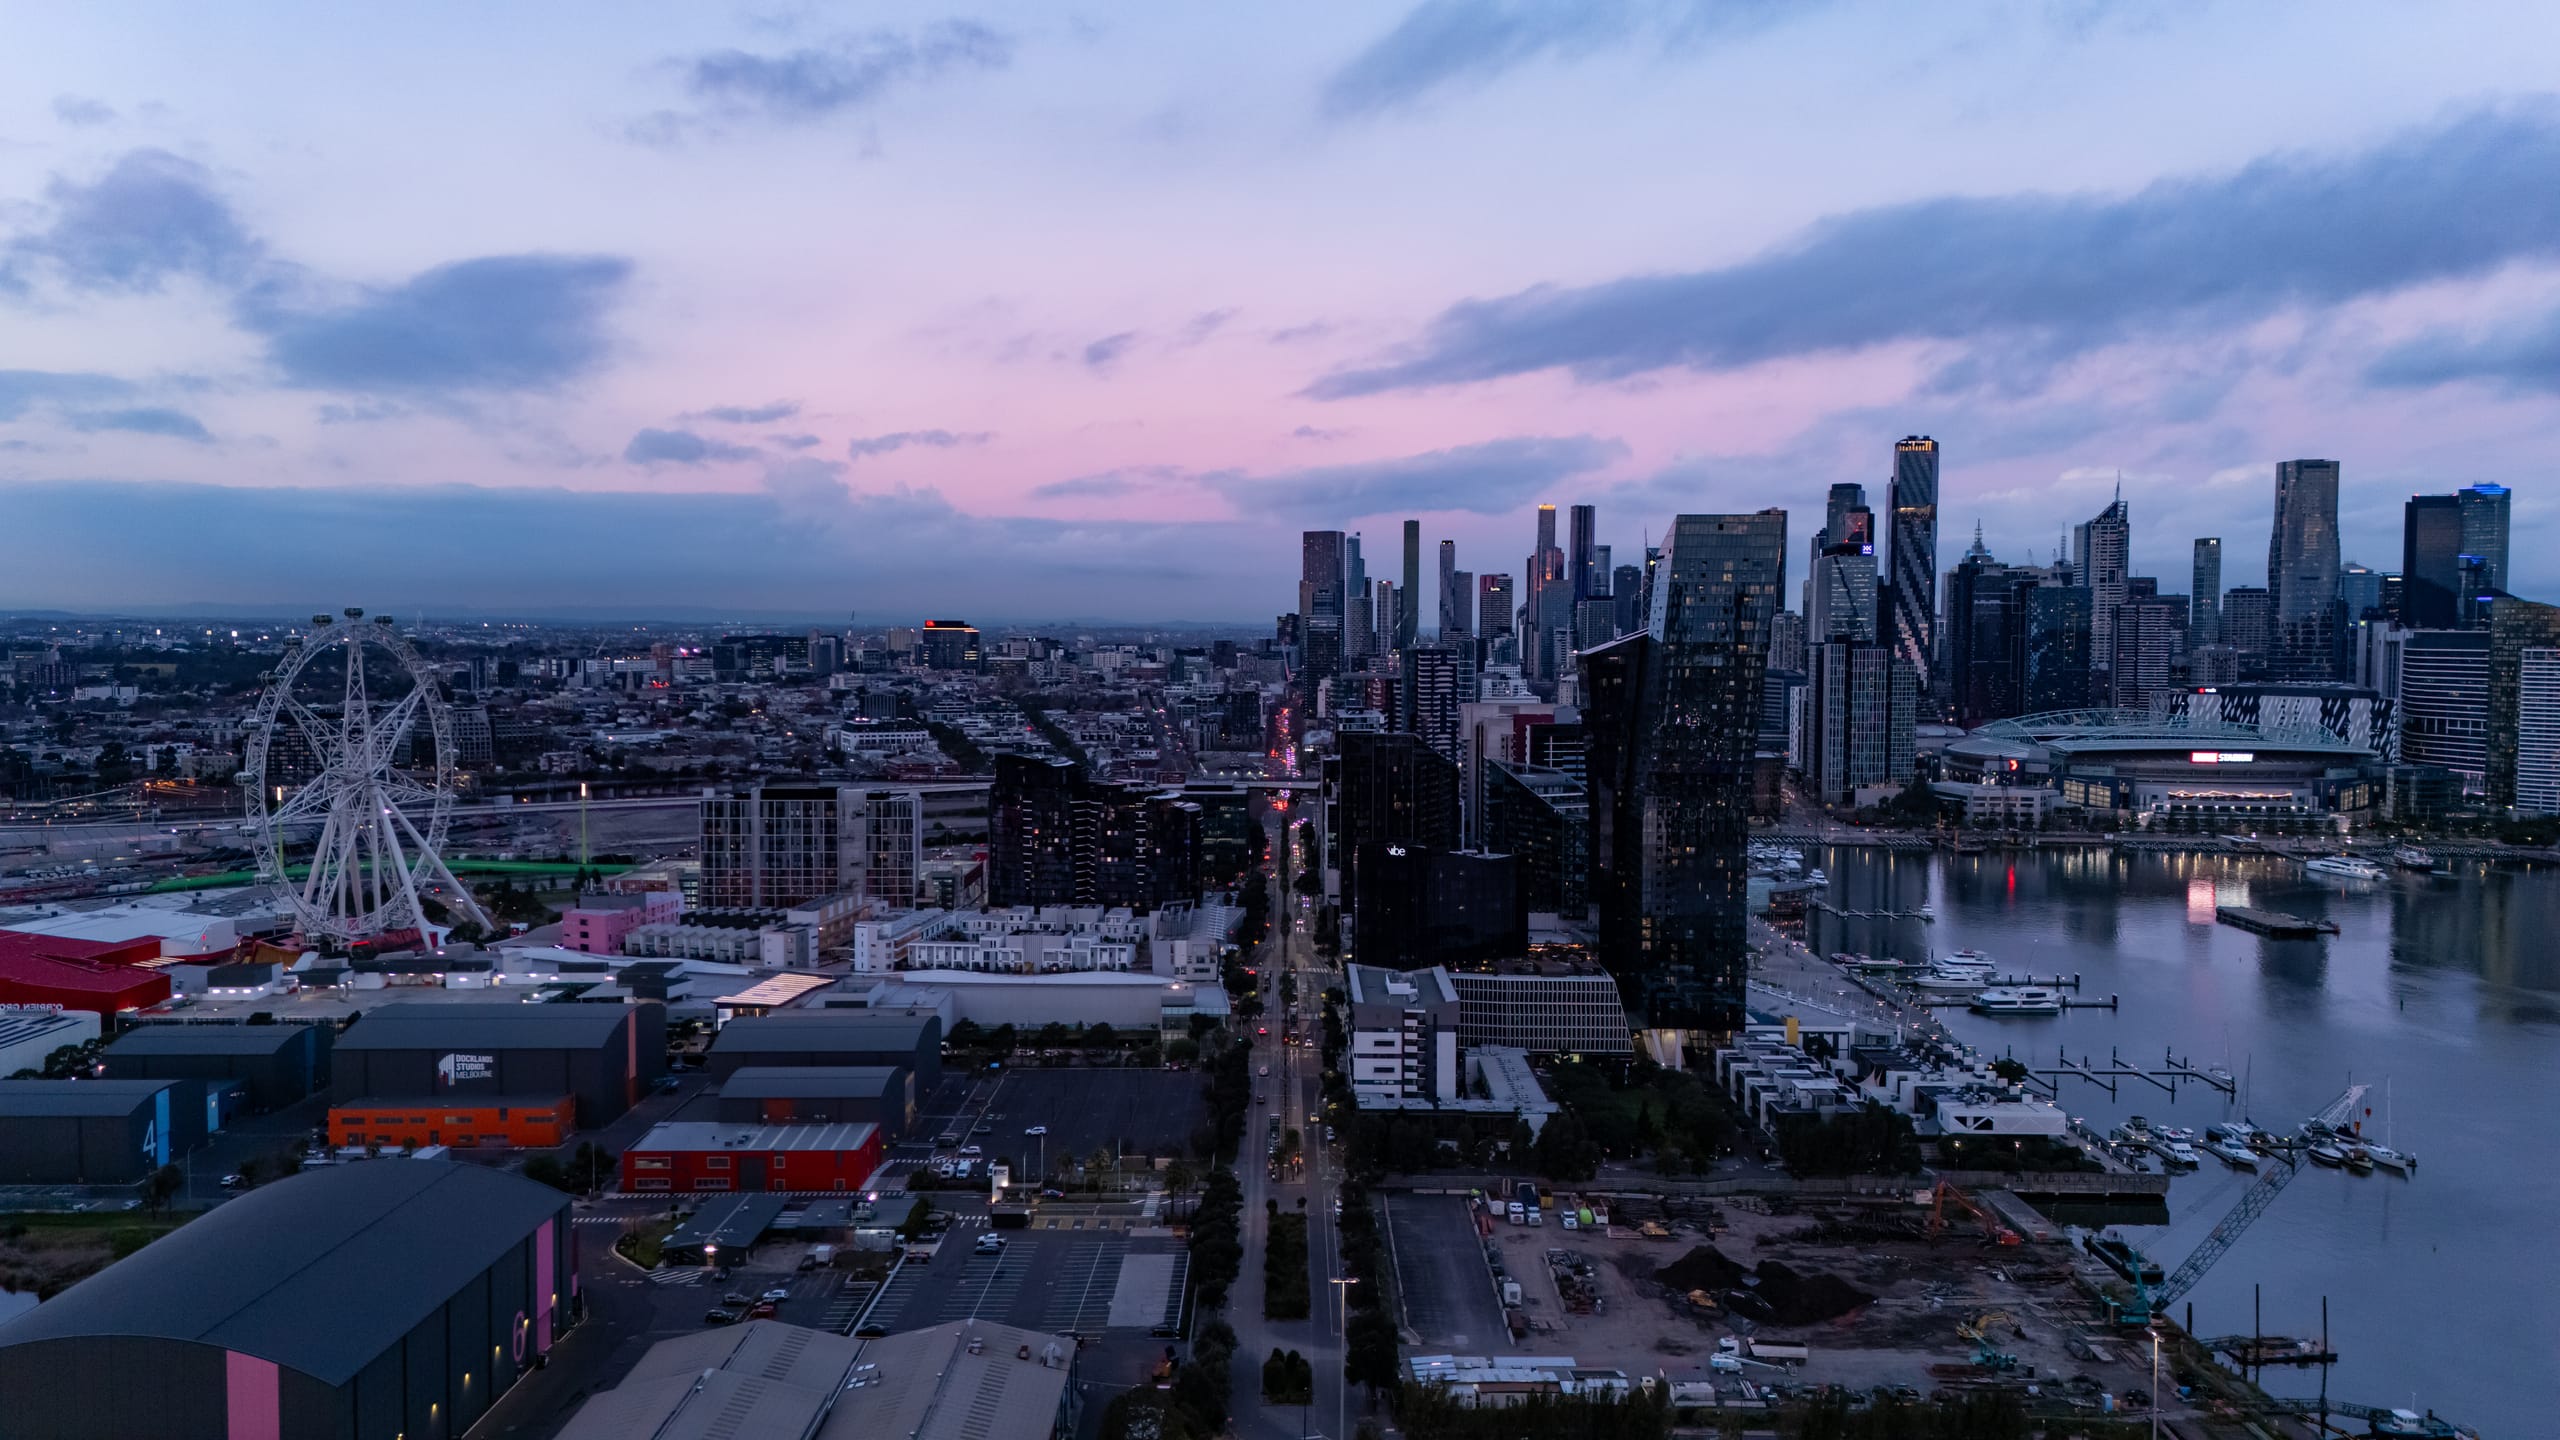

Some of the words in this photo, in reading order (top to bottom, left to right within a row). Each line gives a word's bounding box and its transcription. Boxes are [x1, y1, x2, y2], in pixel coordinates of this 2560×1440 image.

[456, 1054, 493, 1064] DOCKLANDS
[456, 1063, 485, 1071] STUDIOS
[456, 1070, 493, 1079] MELBOURNE
[142, 1119, 157, 1158] 4
[512, 1309, 528, 1363] 6
